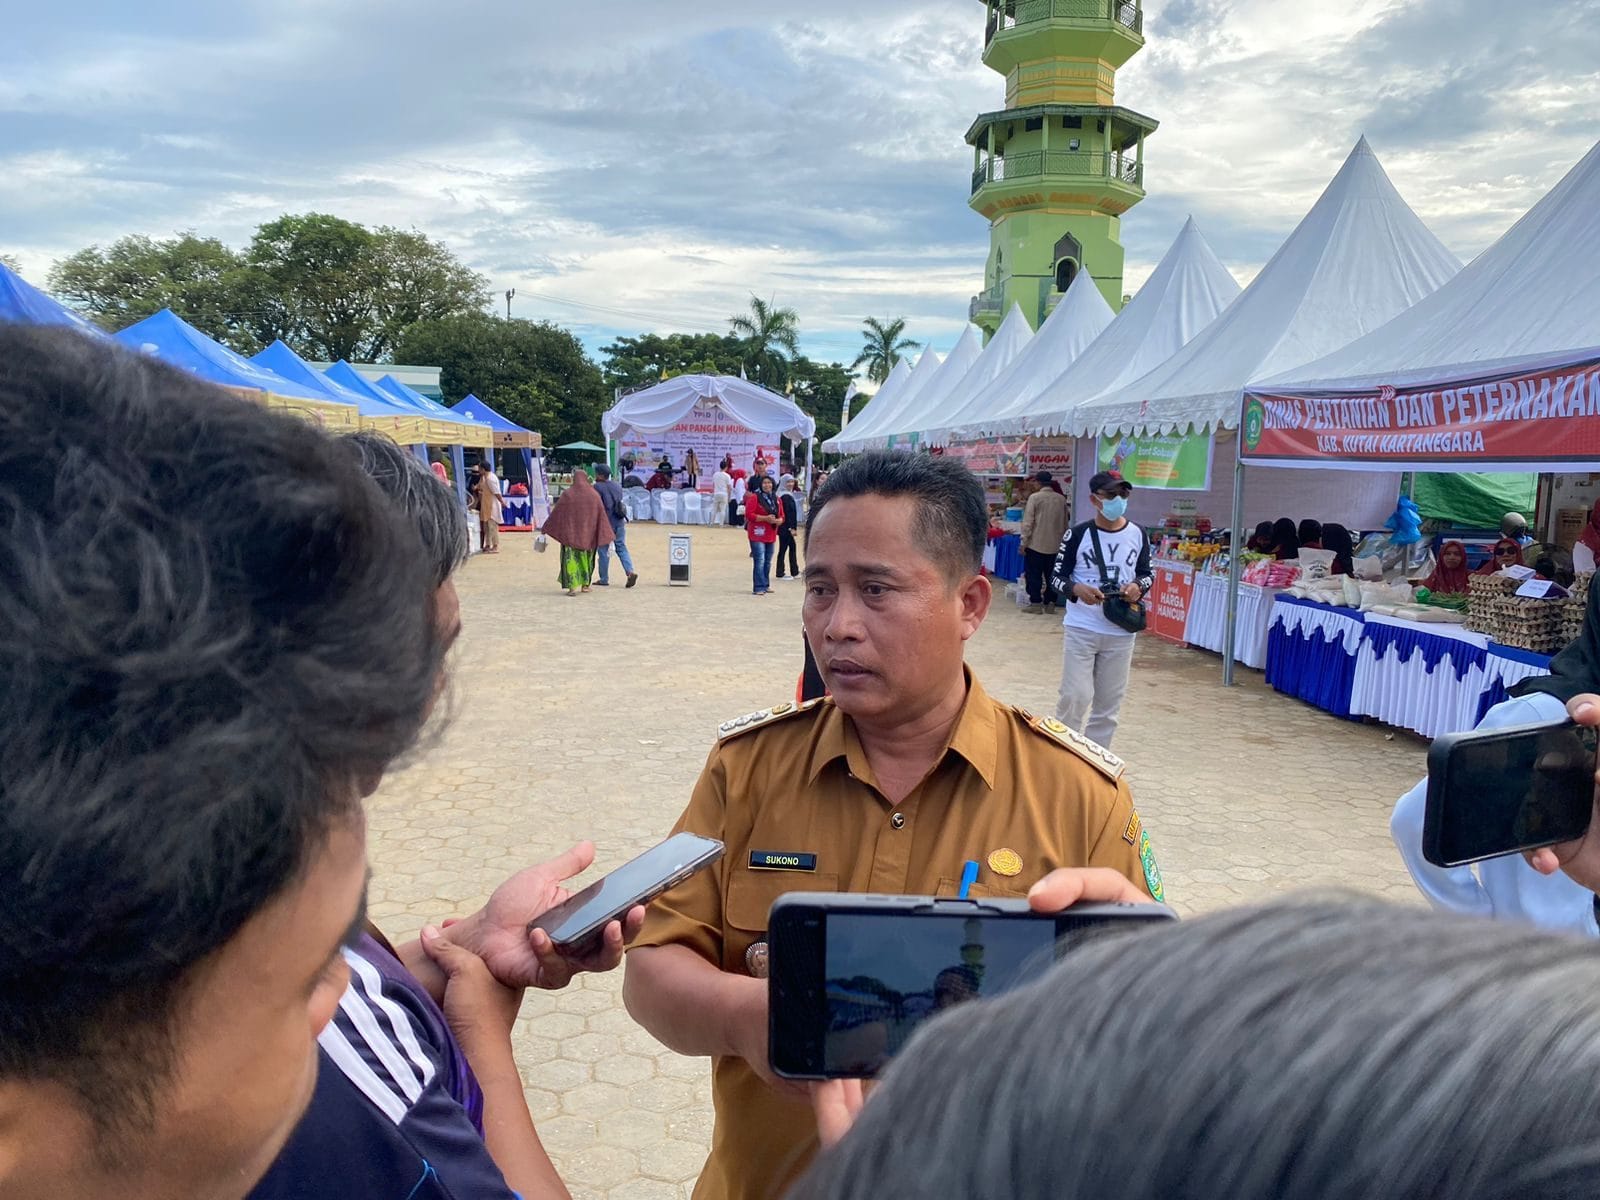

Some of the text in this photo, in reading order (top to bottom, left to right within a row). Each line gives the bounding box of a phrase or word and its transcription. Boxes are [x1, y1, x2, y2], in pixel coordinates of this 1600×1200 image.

[1263, 400, 1301, 430] DINAS
[1302, 398, 1391, 429] PERTANIAN
[1395, 393, 1437, 428] DAN
[689, 424, 723, 433] PANGAN
[1316, 431, 1485, 454] KAB. KUTAI KARTANEGARA
[1053, 542, 1067, 573] NEW
[1082, 543, 1138, 569] NYC
[1160, 592, 1185, 610] HARGA
[1157, 603, 1186, 623] HANCUR
[765, 855, 799, 866] SUKONO
